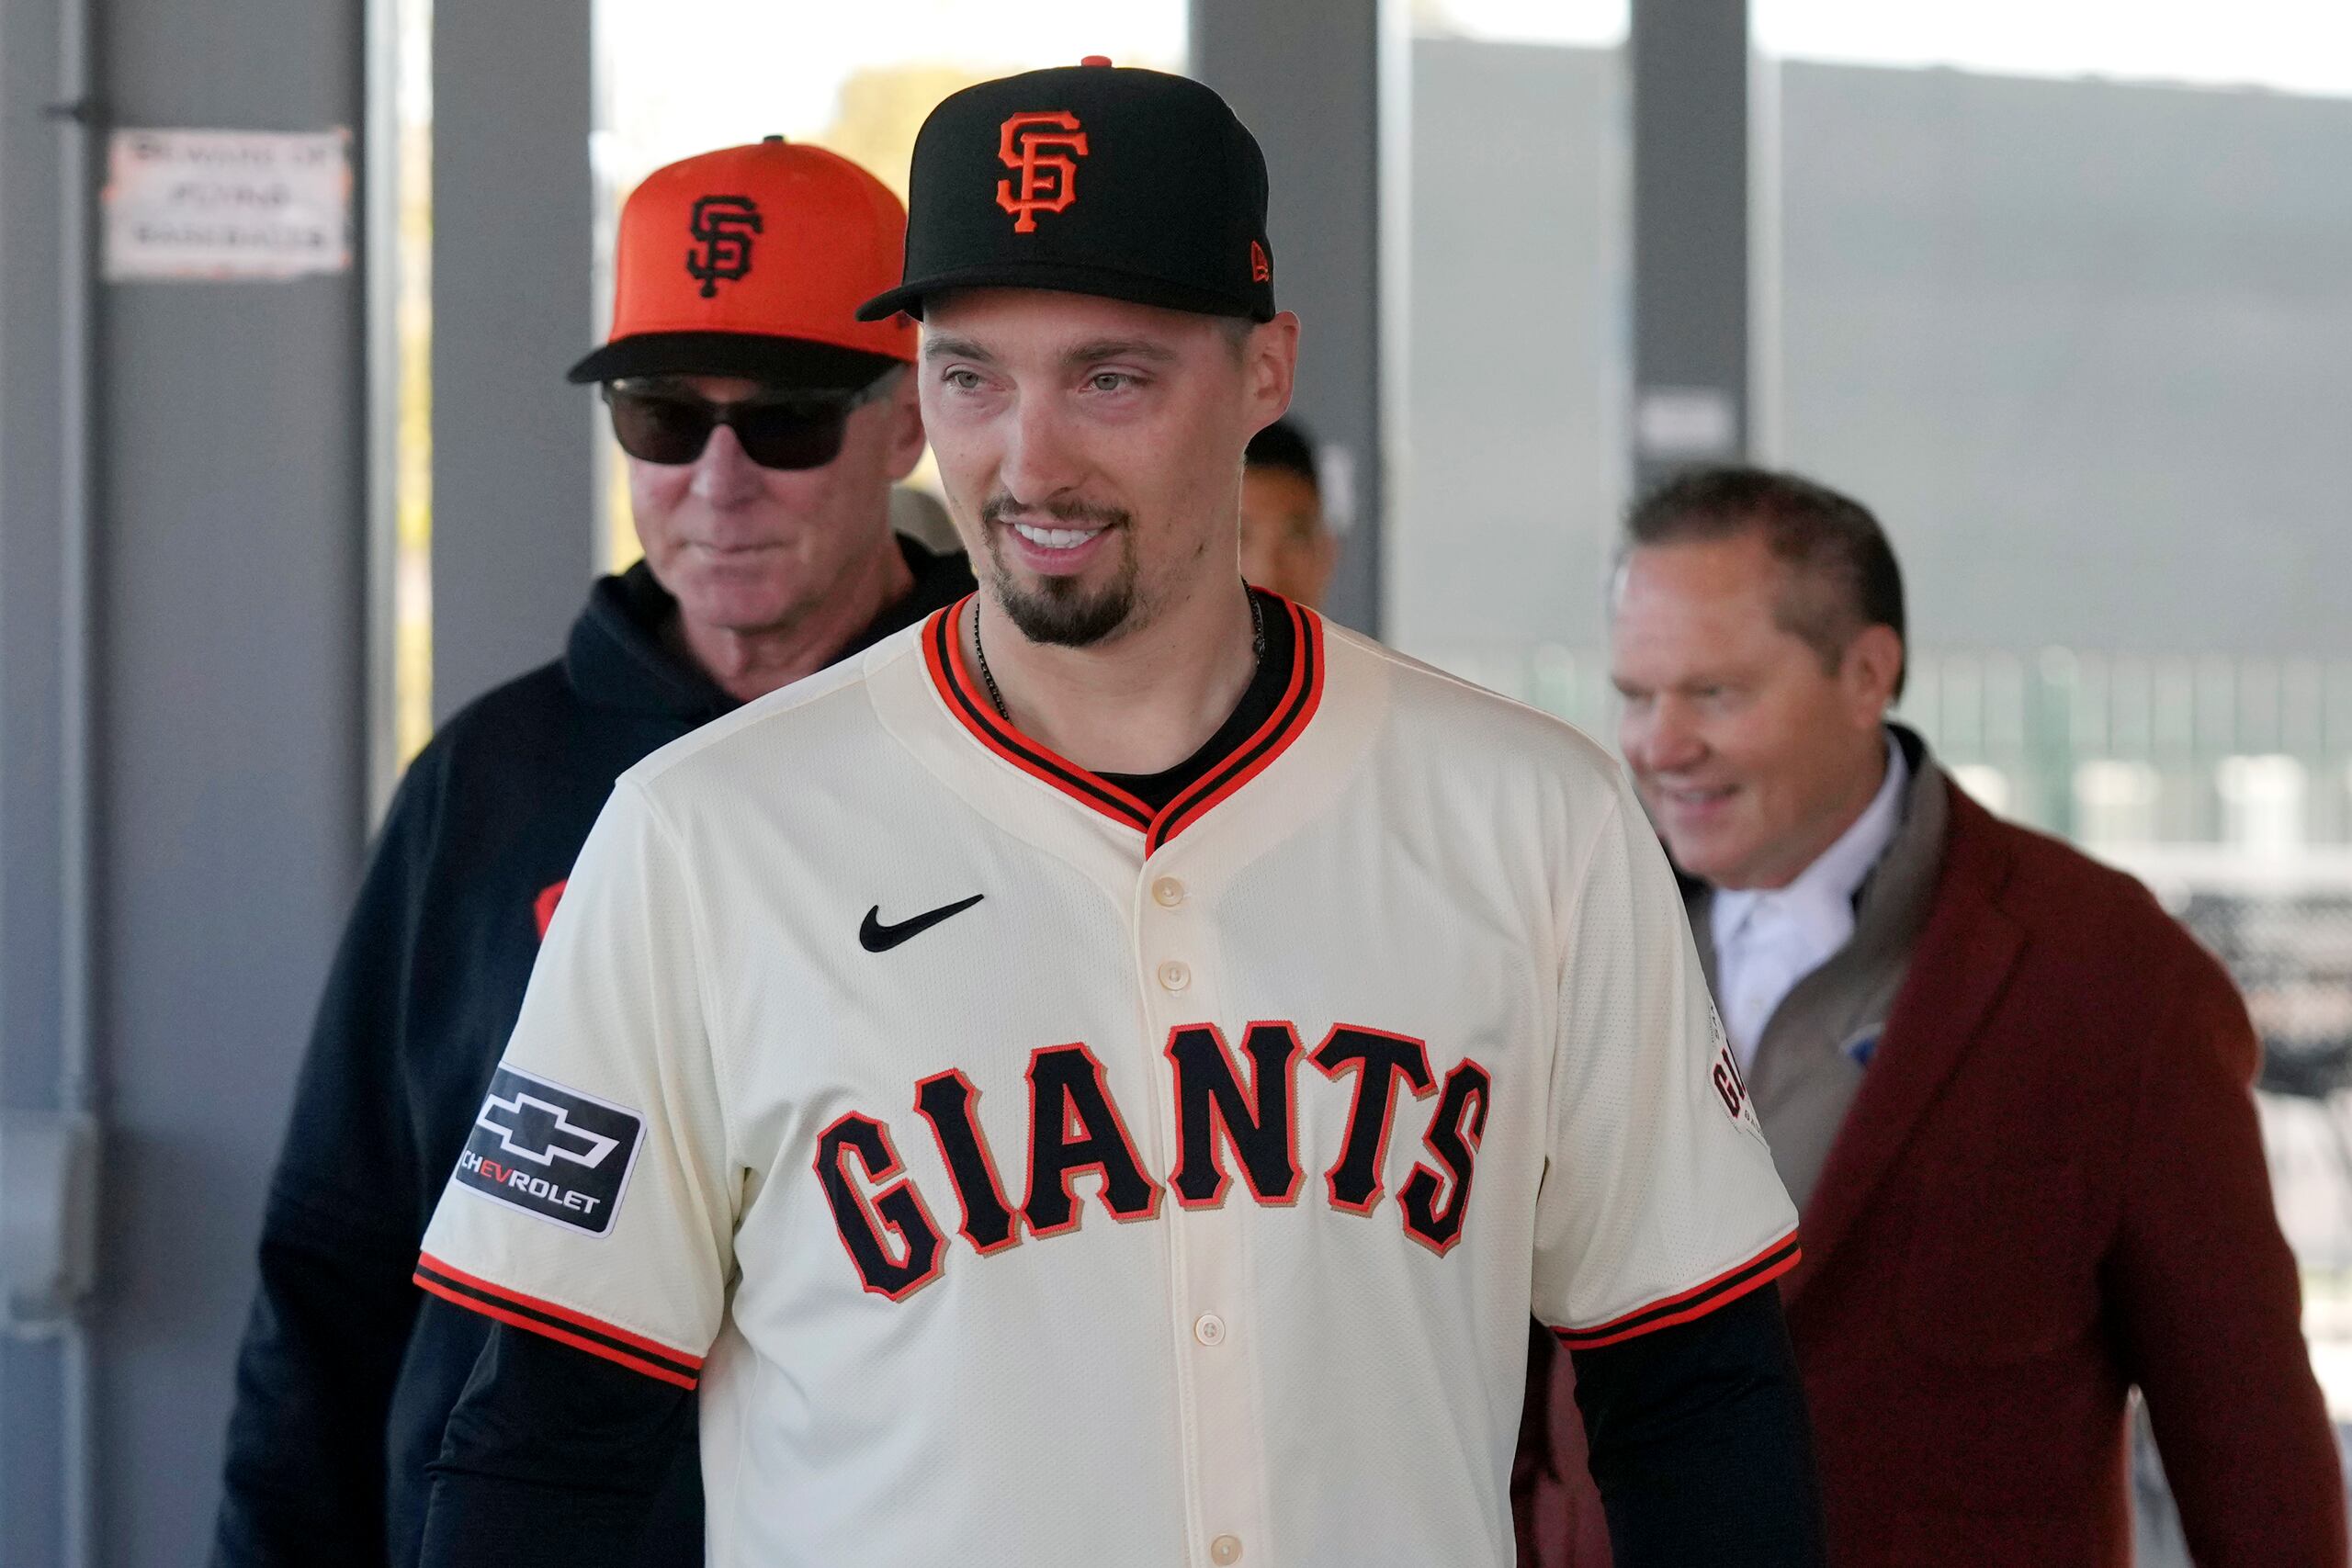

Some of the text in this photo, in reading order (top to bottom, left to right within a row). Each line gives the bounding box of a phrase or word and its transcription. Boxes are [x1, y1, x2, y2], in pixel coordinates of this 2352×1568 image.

[996, 110, 1089, 233] SF
[686, 195, 764, 299] SF
[461, 1149, 601, 1214] CHEVROLET
[812, 1020, 1490, 1303] GIANTS
